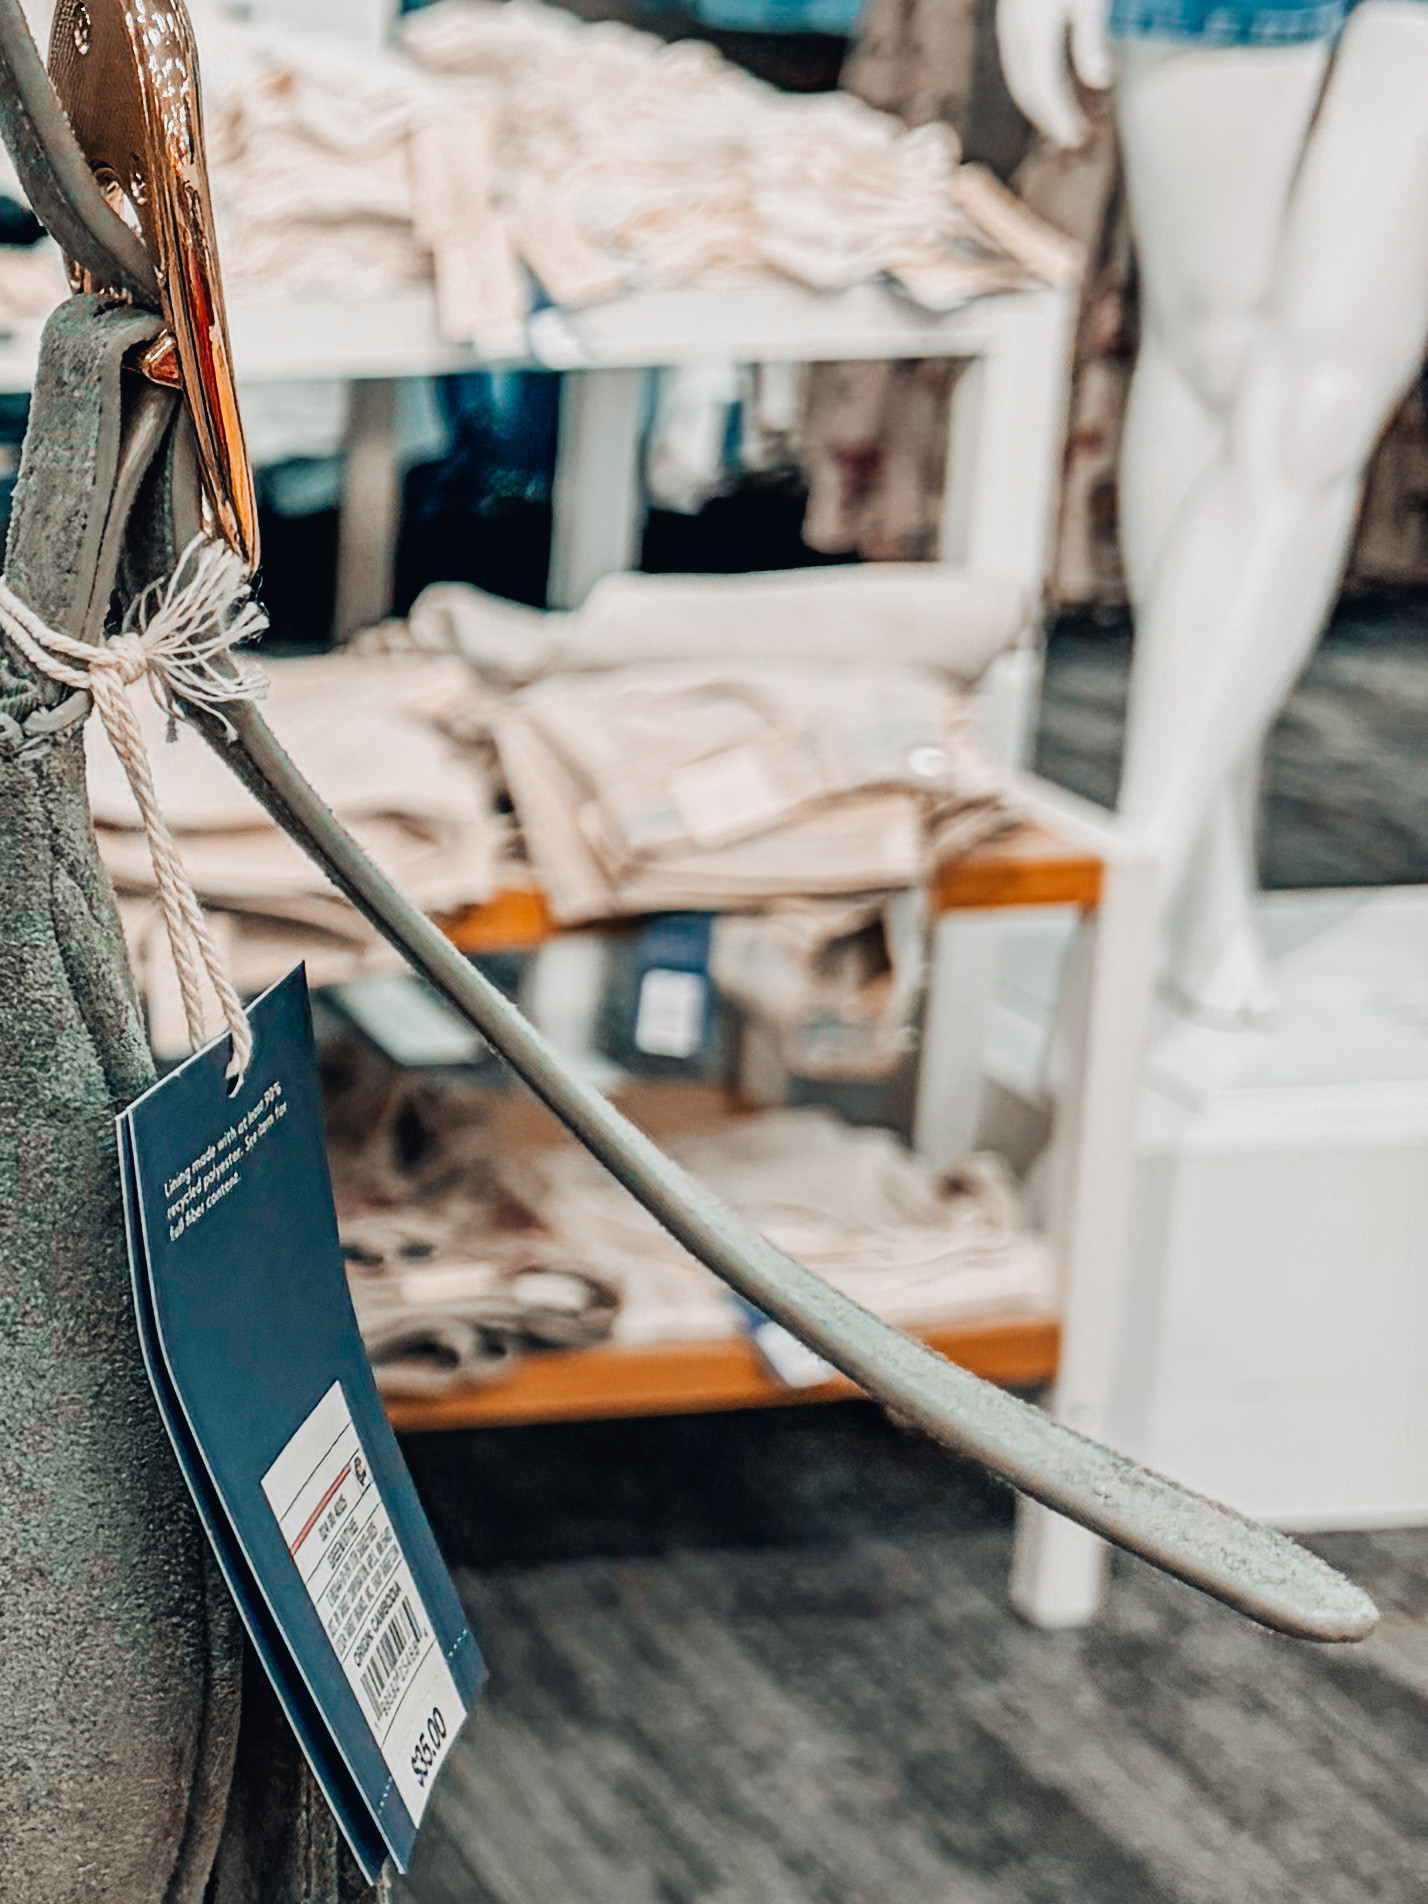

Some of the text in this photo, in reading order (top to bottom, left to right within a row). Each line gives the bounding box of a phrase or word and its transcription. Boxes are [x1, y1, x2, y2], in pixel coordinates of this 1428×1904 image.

[164, 1167, 191, 1198] Lining
[192, 1146, 216, 1173] made
[217, 1126, 237, 1151] with
